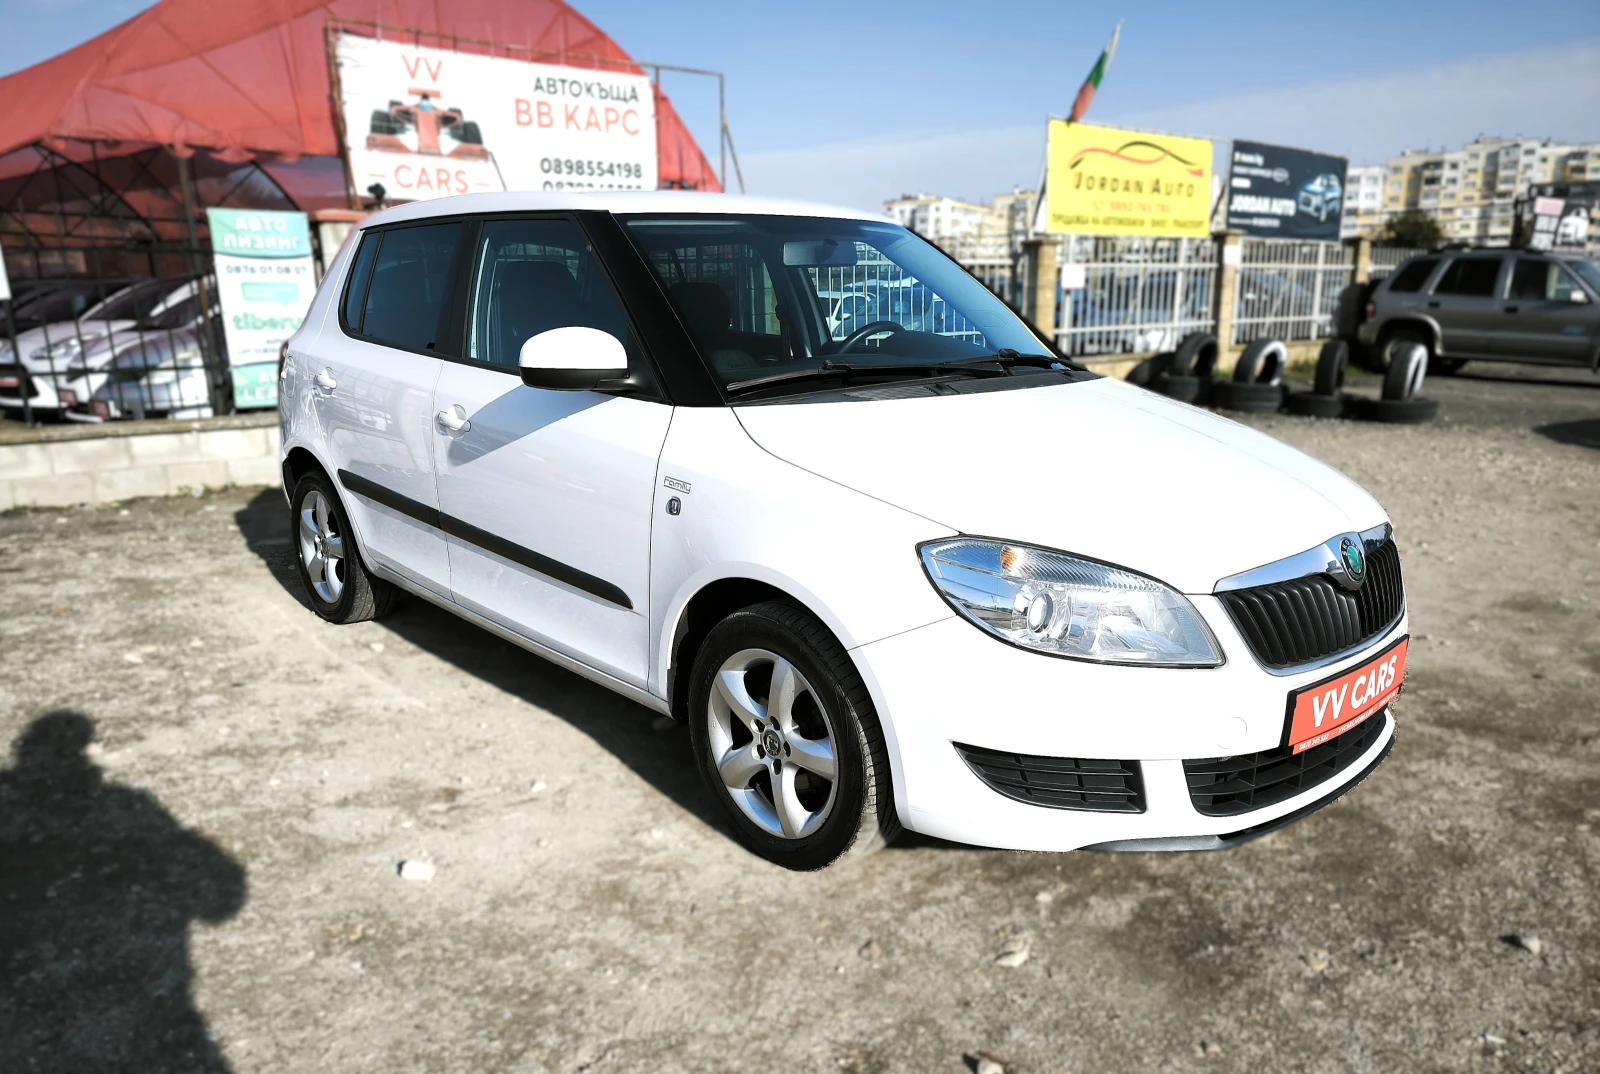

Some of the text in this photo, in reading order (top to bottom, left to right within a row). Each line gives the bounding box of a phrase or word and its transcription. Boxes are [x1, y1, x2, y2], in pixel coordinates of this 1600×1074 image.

[402, 53, 442, 82] VV
[534, 76, 640, 103] АВТОКЪЩА
[515, 98, 640, 136] ВВ КАРС
[394, 165, 469, 194] CARS
[540, 157, 642, 179] 0898554198
[235, 216, 287, 232] АВТО
[1312, 654, 1398, 728] VV CARS
